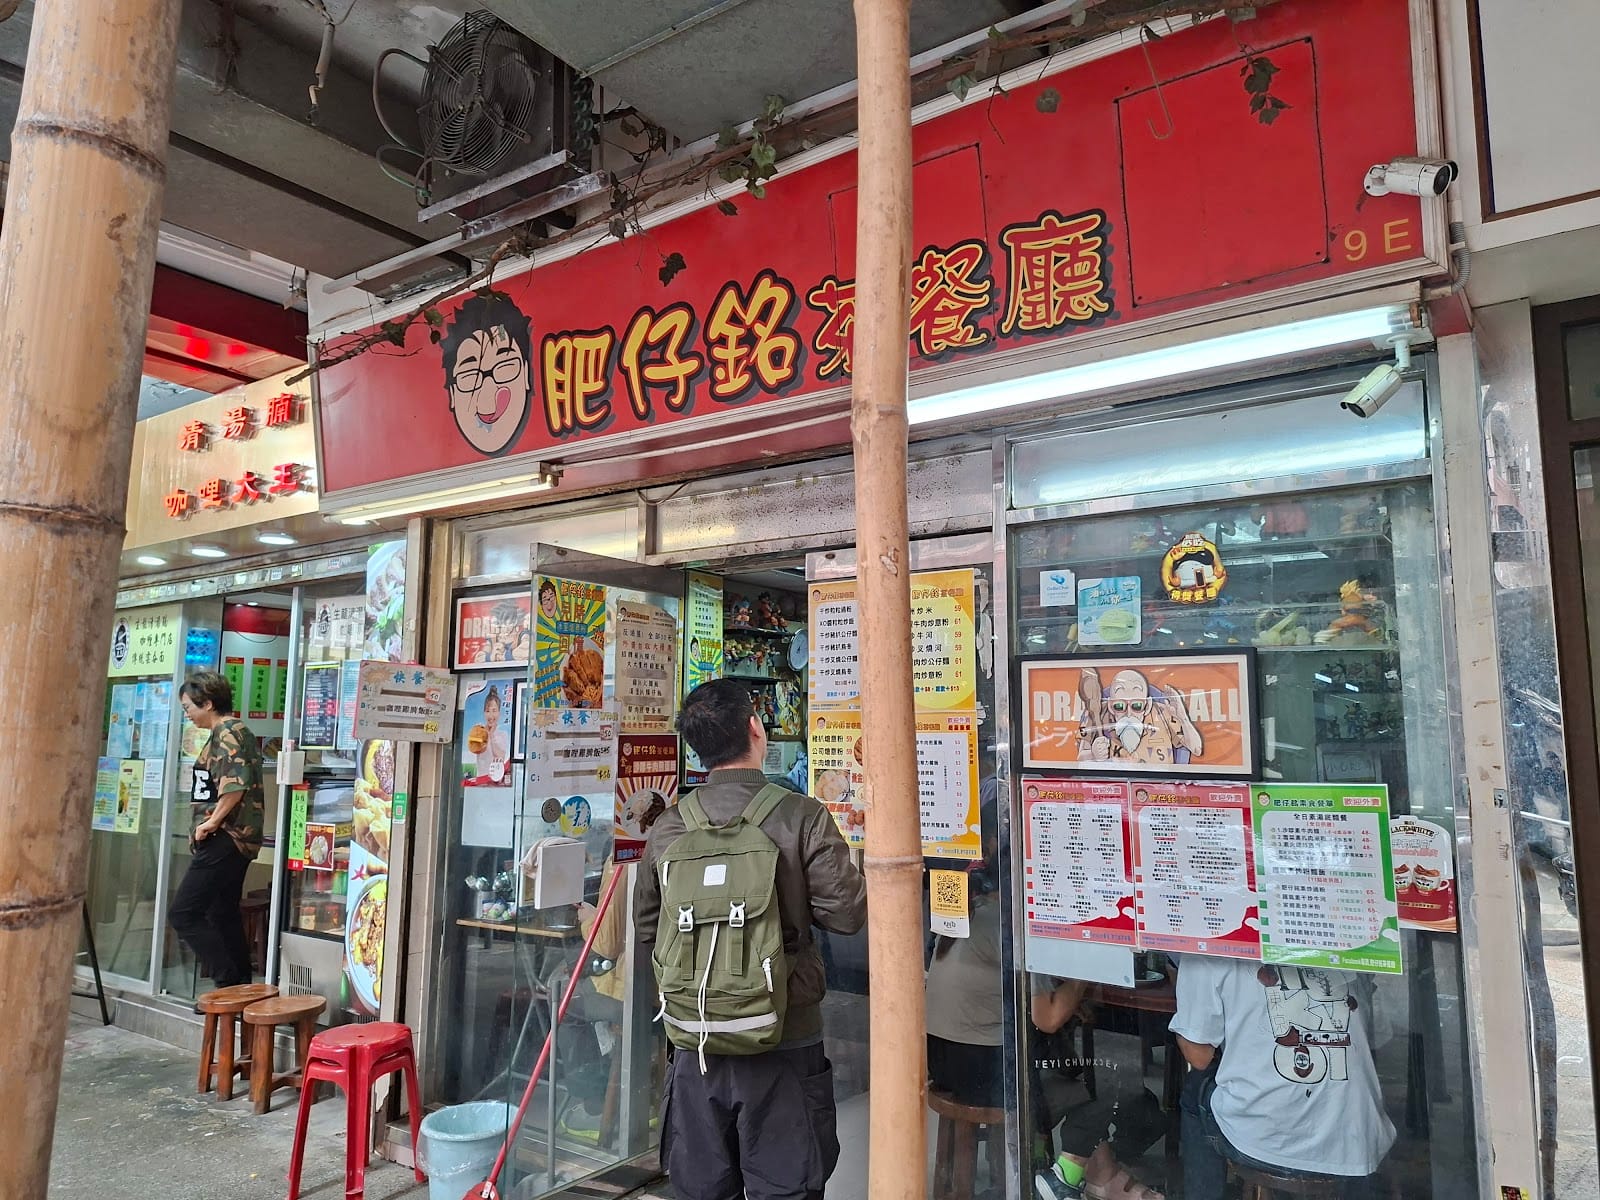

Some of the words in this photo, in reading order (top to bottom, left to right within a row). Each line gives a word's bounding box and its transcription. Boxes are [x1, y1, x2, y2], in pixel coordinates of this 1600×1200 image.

[165, 463, 299, 517] 咖哩大王
[911, 618, 949, 627] 牛肉炒意粉
[393, 670, 425, 685] 快餐
[1033, 690, 1085, 721] DRA
[1178, 688, 1241, 722] ALL
[561, 710, 591, 725] 快餐
